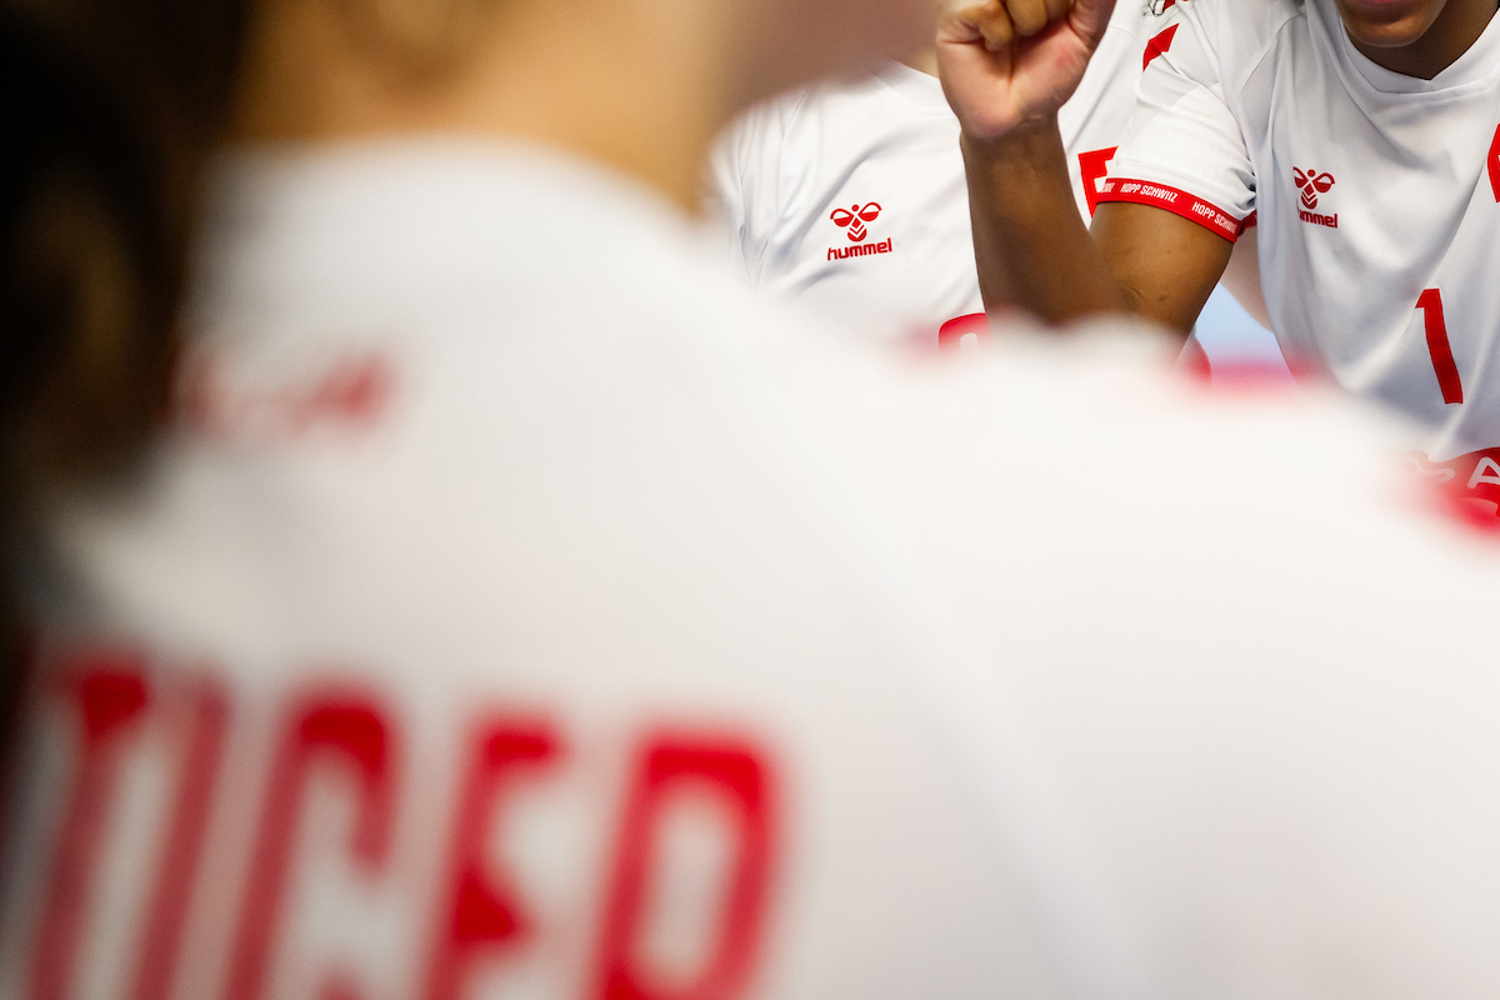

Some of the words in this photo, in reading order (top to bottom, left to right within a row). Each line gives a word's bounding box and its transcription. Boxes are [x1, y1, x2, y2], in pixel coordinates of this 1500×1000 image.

[1120, 183, 1141, 194] HOPP
[1191, 201, 1216, 220] HOPP
[1296, 200, 1338, 229] mmel
[827, 237, 892, 261] hummel
[1413, 287, 1464, 405] 1
